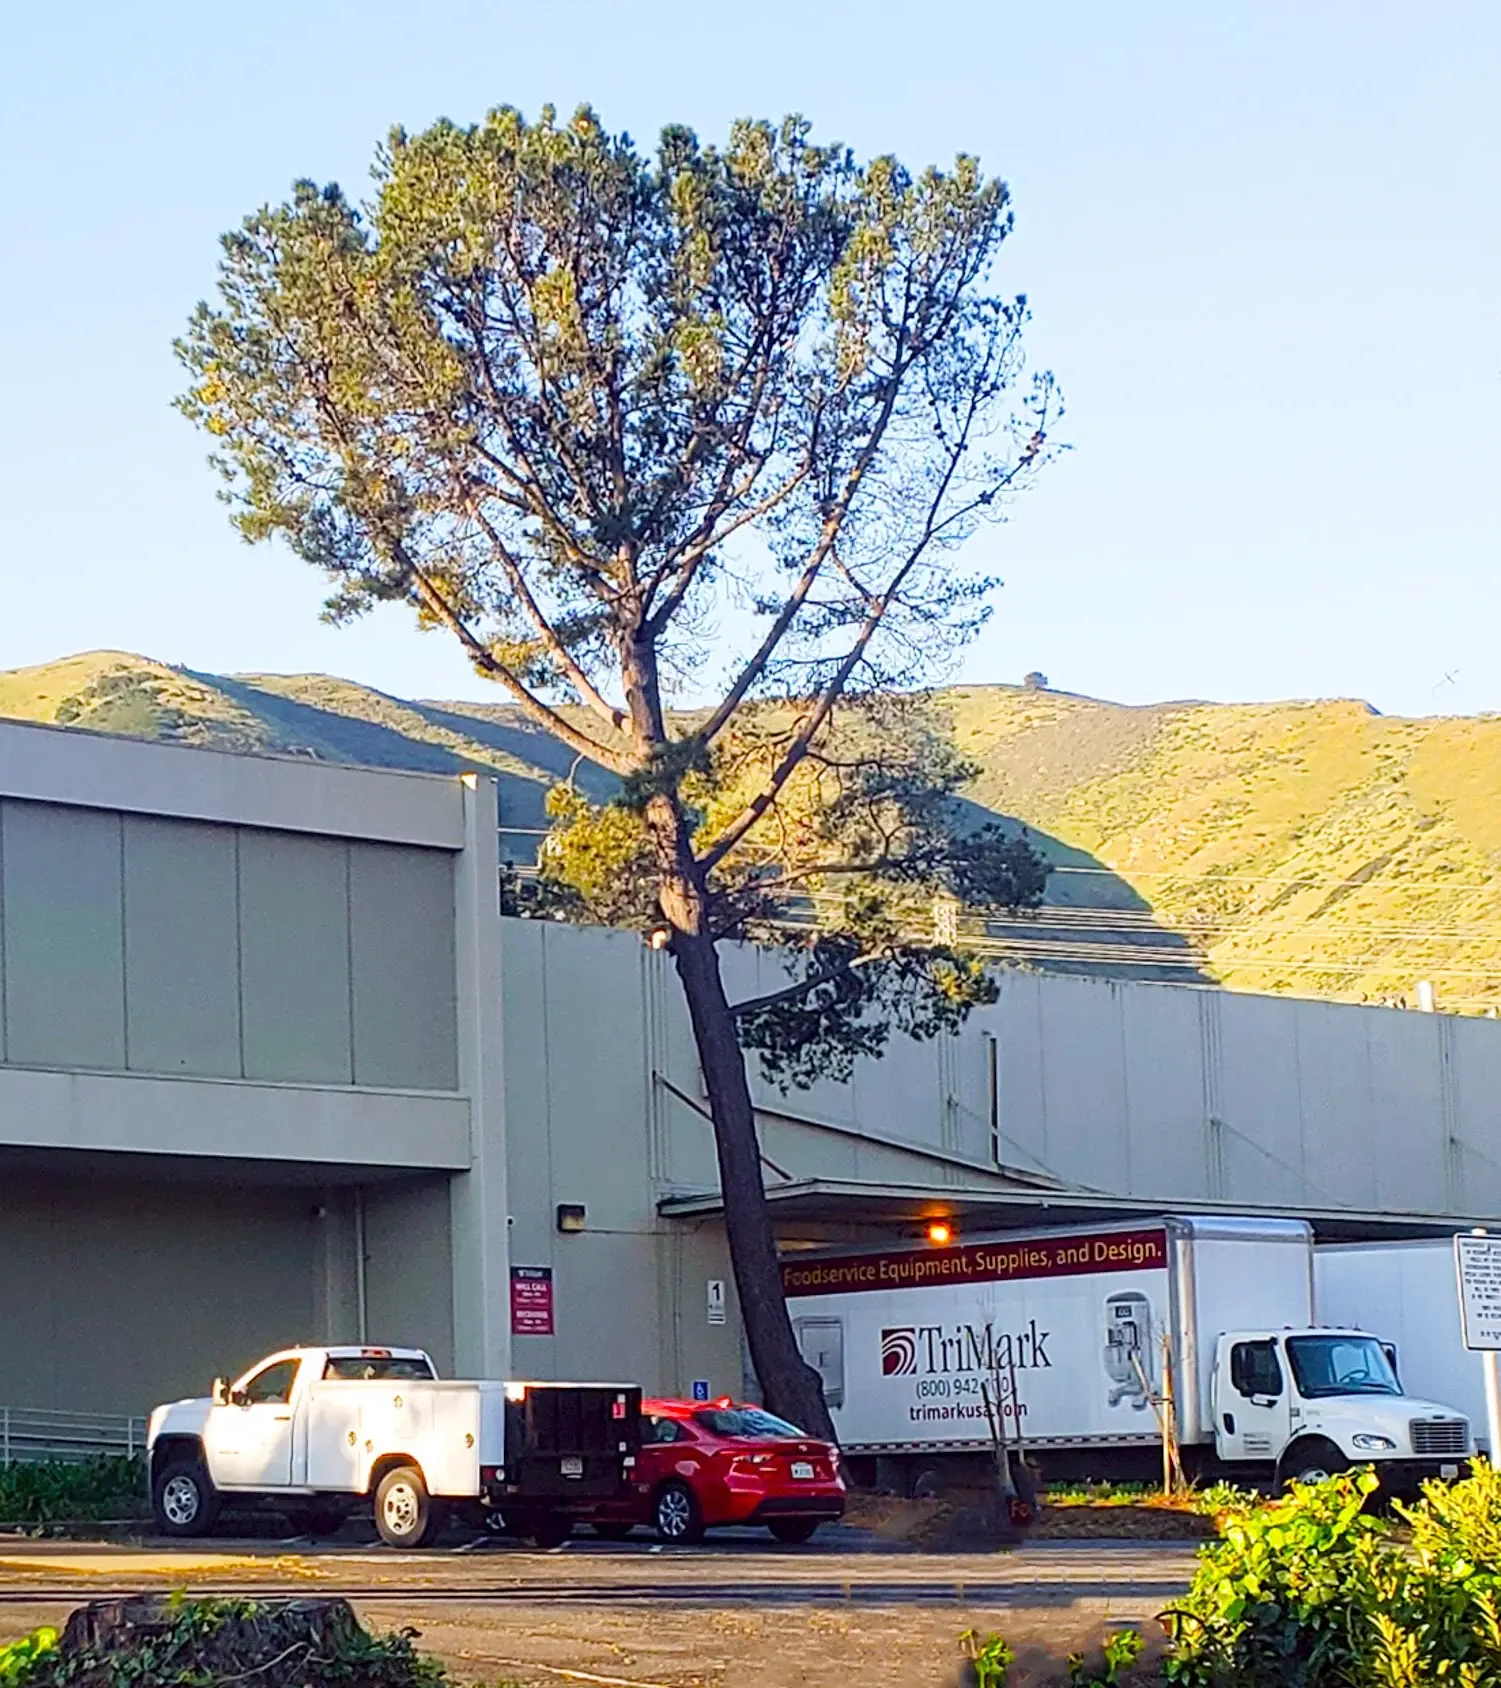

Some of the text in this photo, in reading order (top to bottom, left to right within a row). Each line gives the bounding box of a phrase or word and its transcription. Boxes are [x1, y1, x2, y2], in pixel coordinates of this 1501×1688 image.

[783, 1238, 1162, 1287] Foodservice Equipment, Supplies, and Design.
[712, 1282, 720, 1301] 1
[918, 1318, 1053, 1374] TriMark
[916, 1378, 950, 1399] (800)
